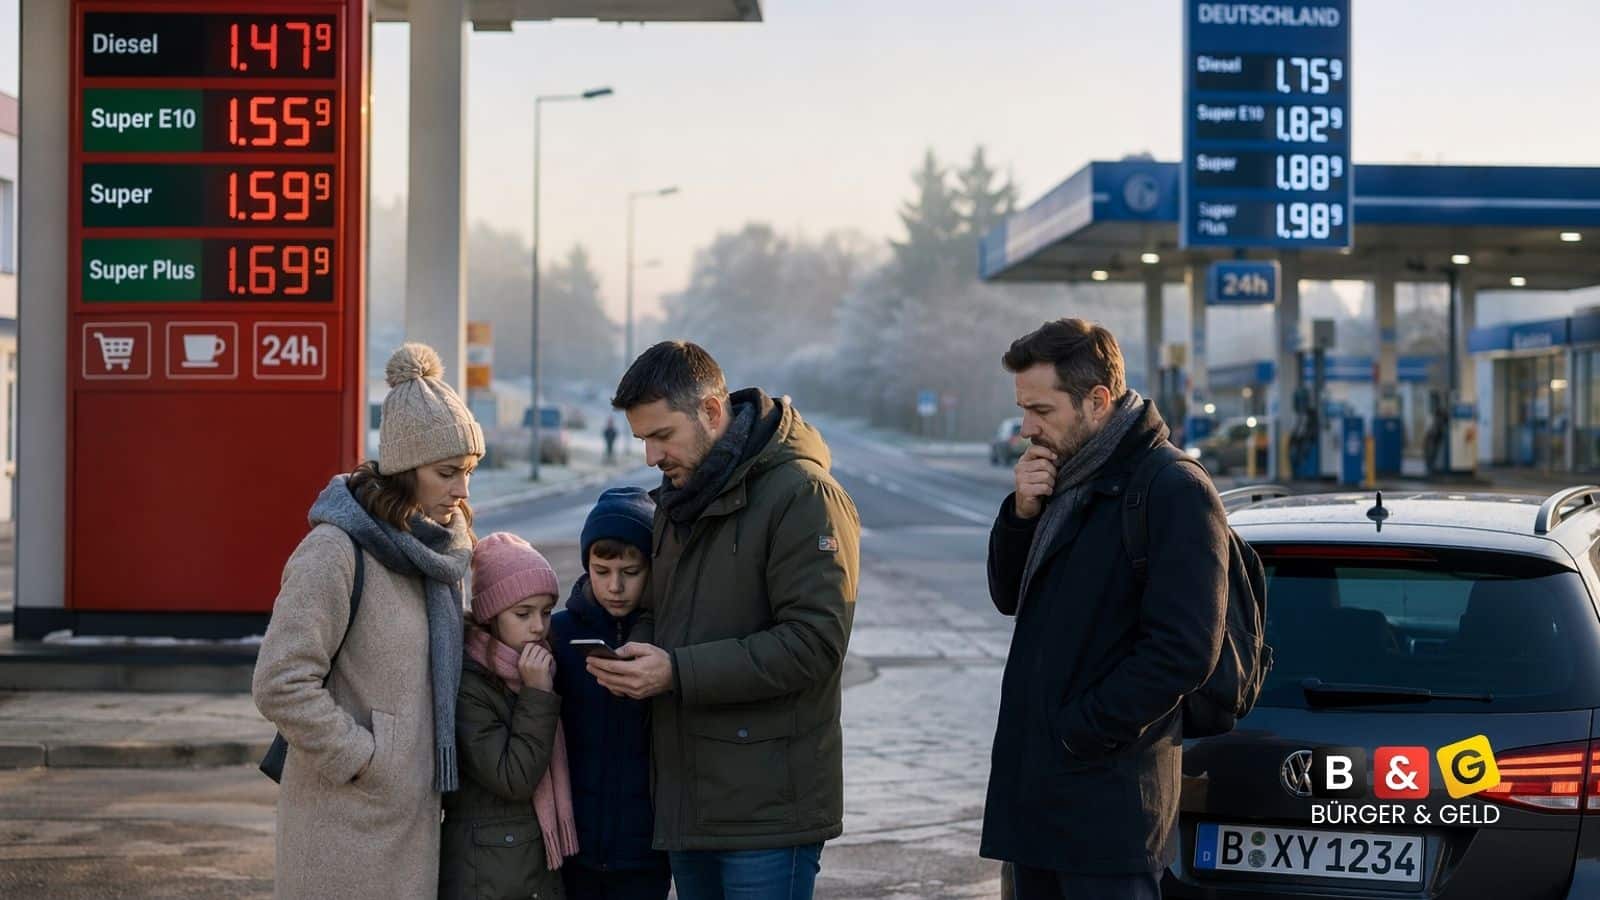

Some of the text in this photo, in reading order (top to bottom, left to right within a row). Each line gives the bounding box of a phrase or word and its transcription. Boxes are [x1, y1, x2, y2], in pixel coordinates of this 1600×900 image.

[1198, 4, 1340, 27] DEUTSCHLAND
[92, 33, 158, 54] Diesel
[1197, 56, 1242, 73] Diesel
[91, 108, 153, 133] Super
[158, 108, 196, 128] E10
[1197, 104, 1237, 123] Super
[1238, 105, 1264, 121] E10
[1197, 154, 1237, 173] Super
[90, 184, 153, 208] Super
[1198, 203, 1237, 220] Super
[89, 259, 148, 284] Super
[152, 260, 195, 280] Plus
[1222, 272, 1269, 295] 24h
[261, 335, 319, 366] 24h
[1221, 831, 1416, 876] B XY 1234
